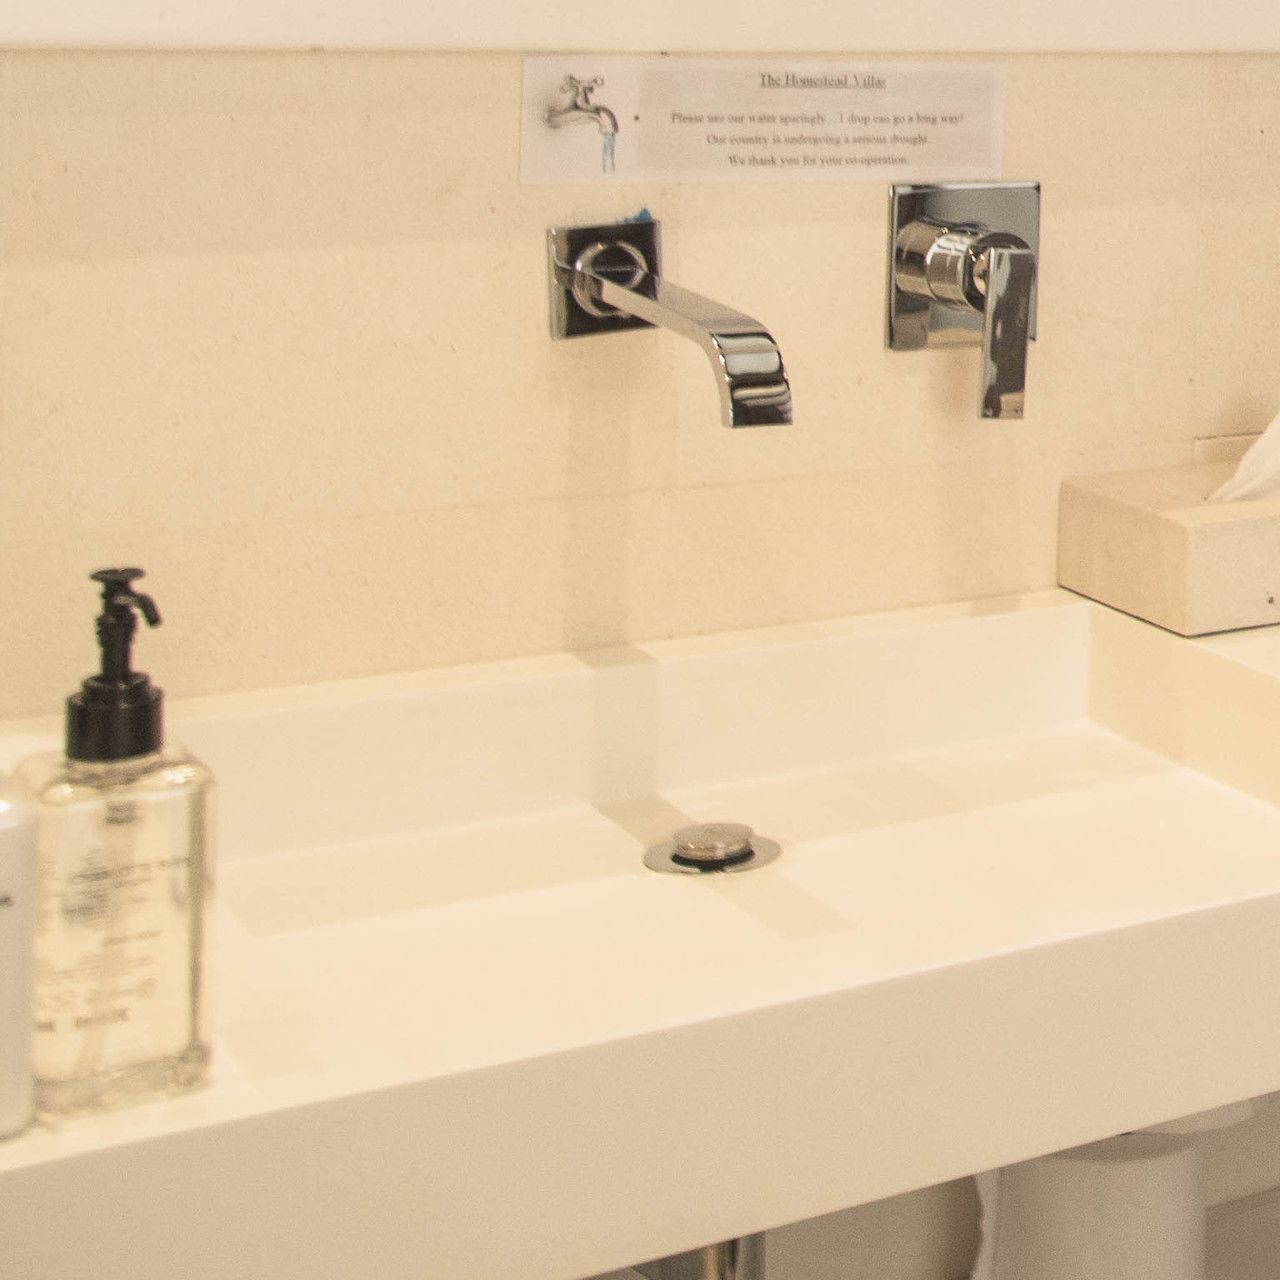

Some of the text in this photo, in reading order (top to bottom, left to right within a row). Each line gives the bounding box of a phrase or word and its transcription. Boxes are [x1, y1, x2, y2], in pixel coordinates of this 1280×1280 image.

[761, 72, 781, 90] The
[672, 112, 704, 124] Please
[747, 113, 776, 124] water
[848, 112, 870, 128] drop
[916, 112, 938, 128] long
[728, 134, 768, 148] country
[728, 155, 745, 166] We
[748, 154, 776, 166] thank
[780, 157, 800, 169] you
